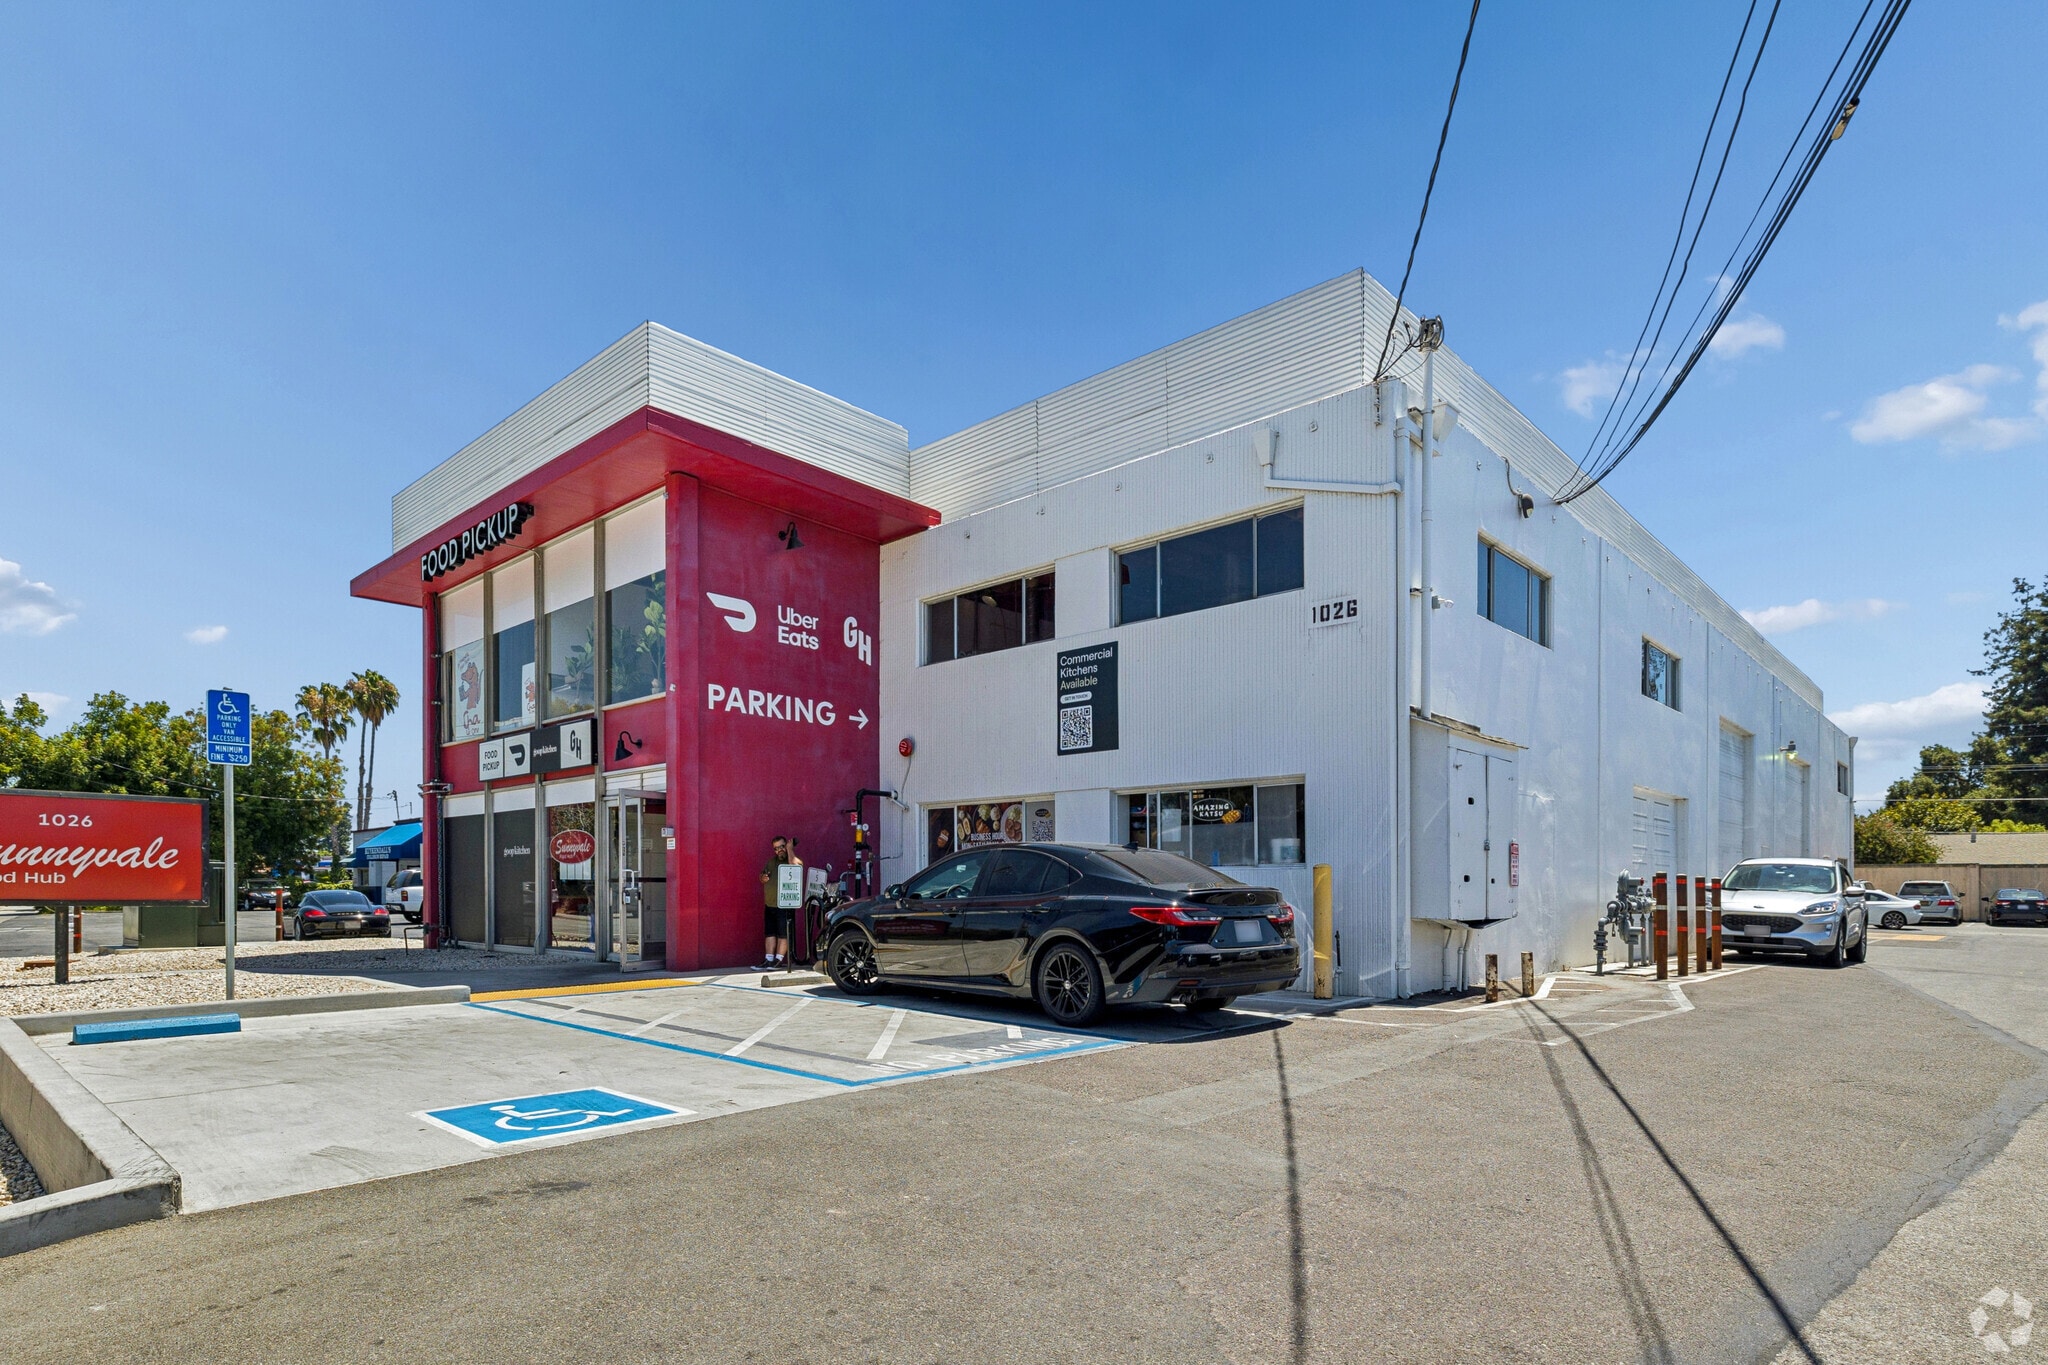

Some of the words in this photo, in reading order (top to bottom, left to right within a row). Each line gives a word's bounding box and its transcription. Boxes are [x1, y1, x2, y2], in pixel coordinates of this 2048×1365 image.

[421, 538, 458, 581] FOOD
[462, 503, 519, 559] PICKUP
[777, 605, 819, 630] Uber
[1312, 599, 1358, 624] 1026
[777, 625, 820, 650] Eats
[843, 616, 872, 667] GH
[1060, 647, 1113, 666] Commercial
[1060, 664, 1098, 679] Kitchens
[1060, 676, 1098, 691] Available
[708, 683, 836, 726] PARKING
[216, 714, 242, 723] PARKING
[221, 721, 237, 729] ONLY
[212, 734, 246, 743] ACCESSIBLE
[570, 730, 582, 760] GH
[215, 745, 243, 754] MINIMUM
[484, 750, 498, 760] FOOD
[210, 752, 225, 761] FINE
[228, 753, 248, 763] $250
[482, 761, 500, 772] PICKUP
[1193, 803, 1229, 812] AMAZING
[38, 813, 93, 828] 1026
[24, 872, 66, 884] Hub
[788, 871, 793, 881] 5
[782, 882, 799, 891] MINUTE
[780, 892, 800, 902] PARKING
[871, 1060, 928, 1074] NO
[927, 1036, 1085, 1064] PARKING
